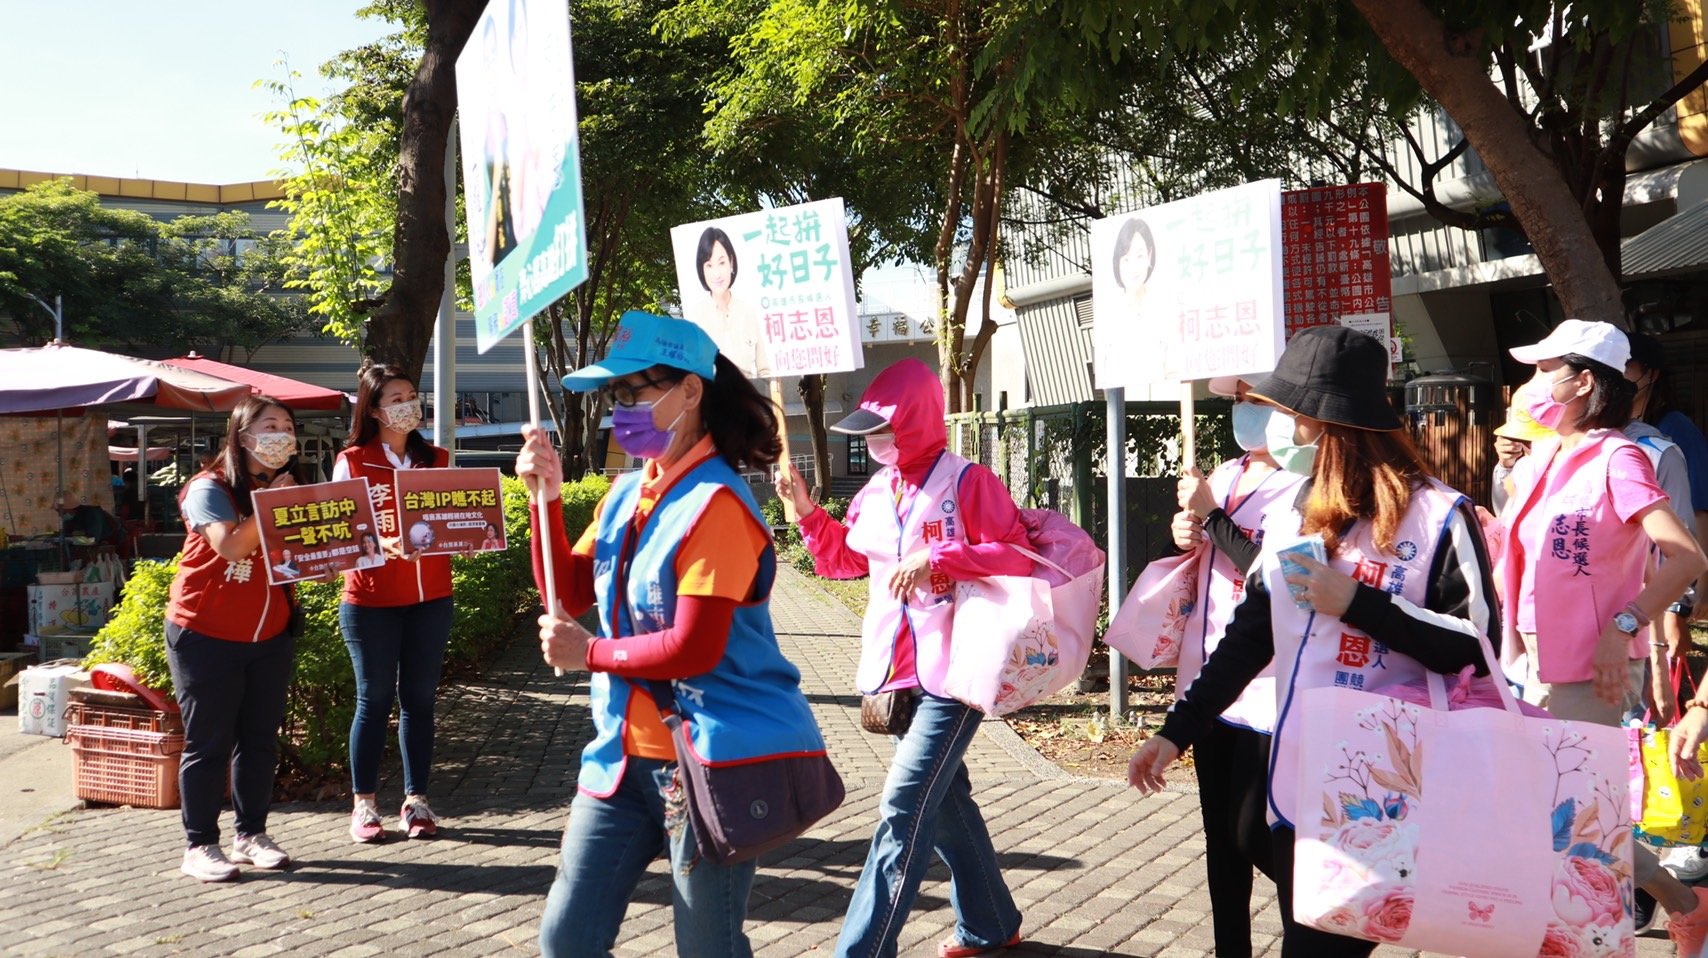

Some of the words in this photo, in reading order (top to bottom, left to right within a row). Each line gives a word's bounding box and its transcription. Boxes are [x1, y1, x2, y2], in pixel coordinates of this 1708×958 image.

[757, 243, 838, 290] 好日子
[1177, 228, 1267, 286] 好日子
[764, 307, 839, 344] 柯志恩
[1178, 298, 1261, 344] 柯志恩
[775, 345, 840, 371] 向您問好
[272, 497, 356, 527] 夏立言訪中
[404, 489, 496, 510] 台灣IP瞧不起
[284, 520, 353, 545] 一聲不吭
[224, 559, 254, 583] 樺
